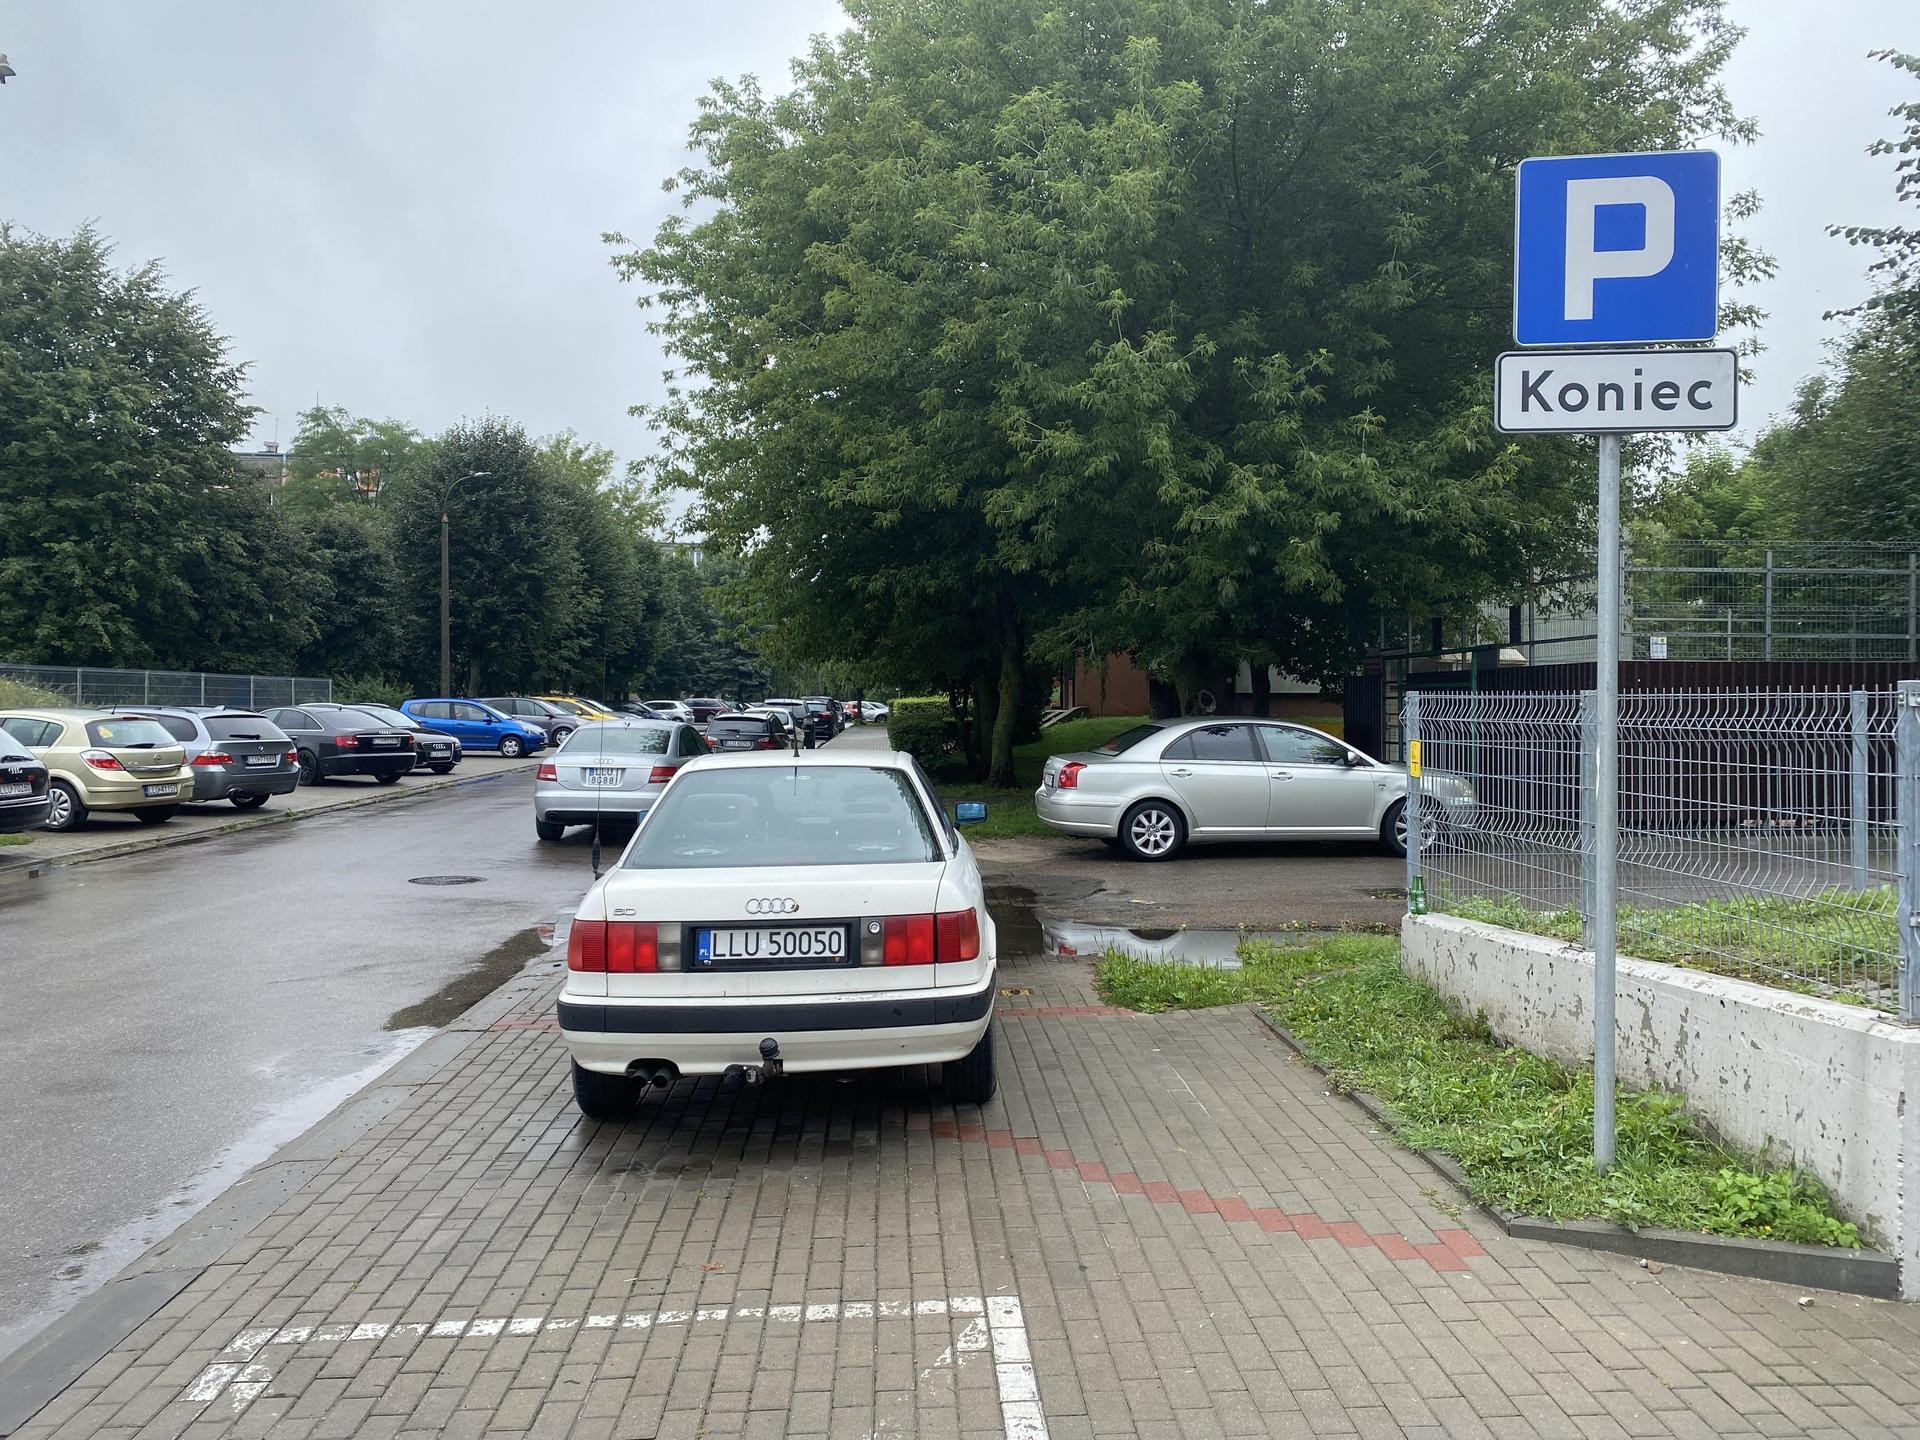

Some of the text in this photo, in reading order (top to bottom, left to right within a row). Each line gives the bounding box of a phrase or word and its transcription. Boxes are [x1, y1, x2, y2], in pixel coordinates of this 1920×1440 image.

[1564, 175, 1676, 321] P
[1521, 368, 1713, 412] Koniec
[596, 767, 613, 776] LLU
[613, 908, 636, 916] 80
[700, 931, 842, 957] PL LLU 50050
